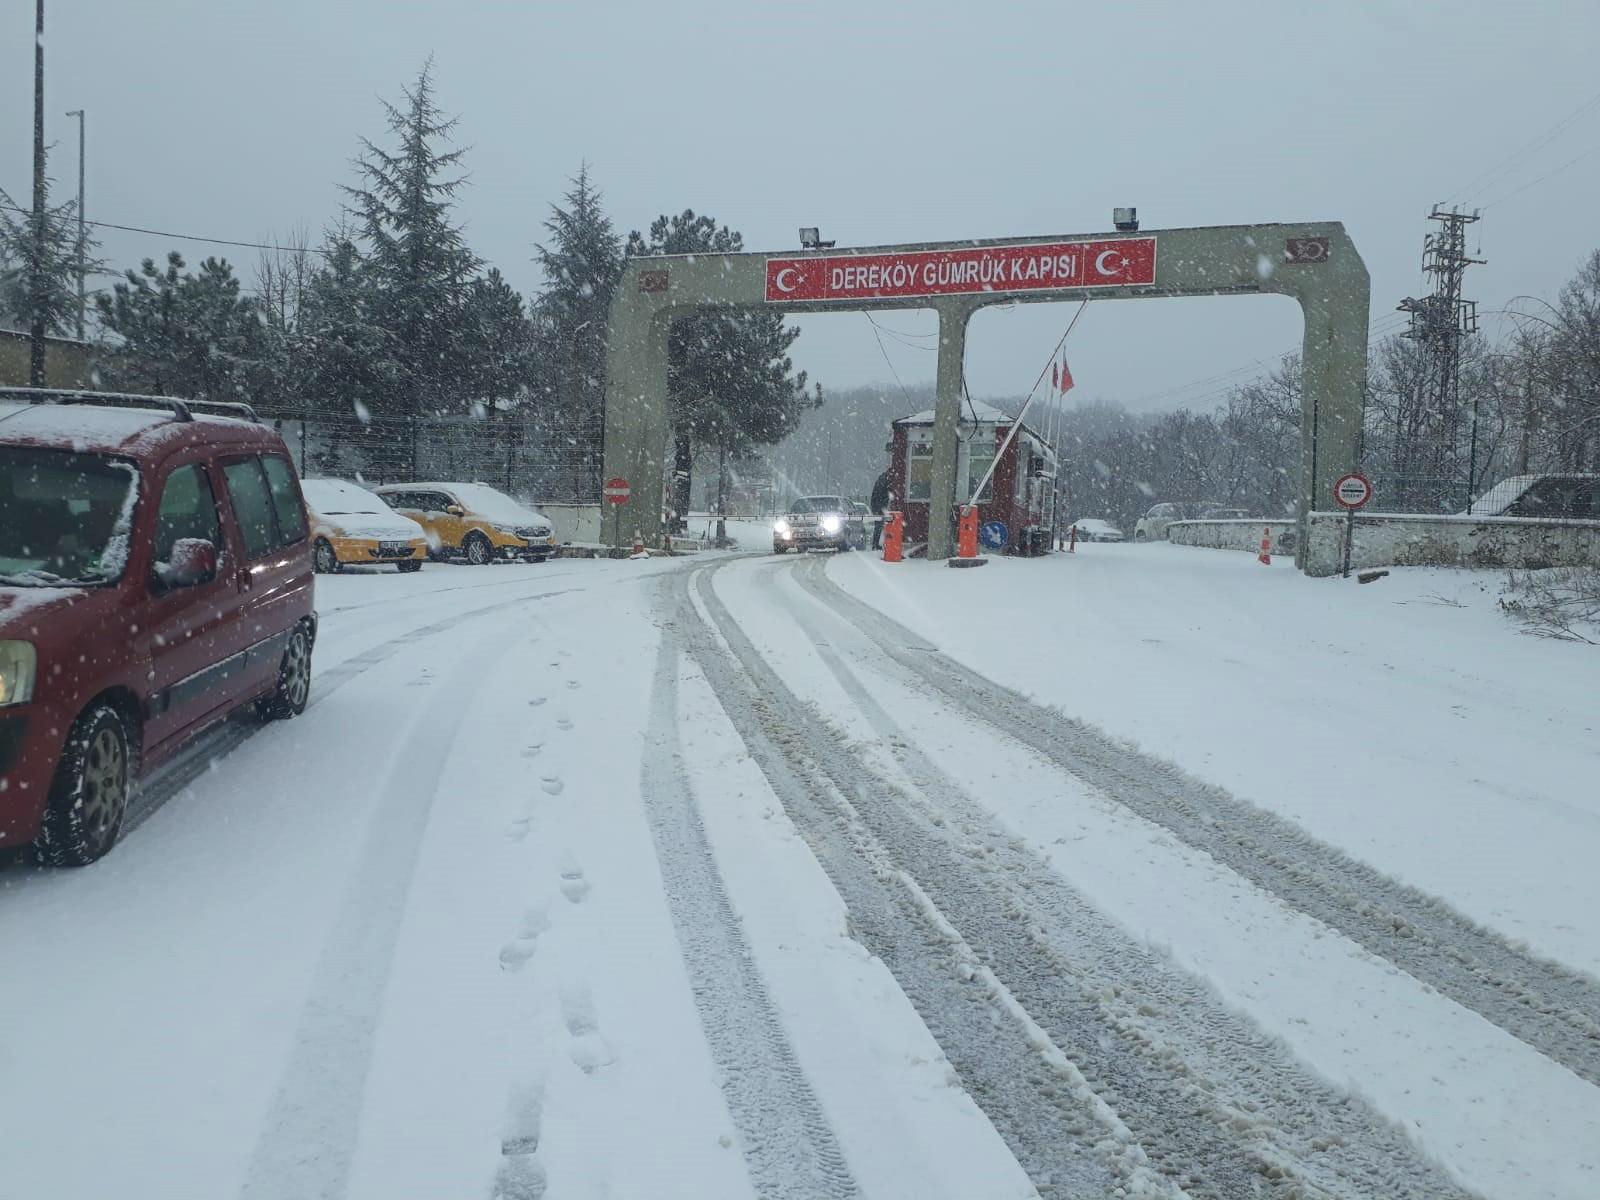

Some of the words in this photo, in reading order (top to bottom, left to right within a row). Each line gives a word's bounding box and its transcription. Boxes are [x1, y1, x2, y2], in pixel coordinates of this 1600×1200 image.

[832, 260, 919, 290] DEREKÖY
[923, 255, 1006, 286] GÜMRÜK
[1011, 255, 1076, 281] KAPISI
